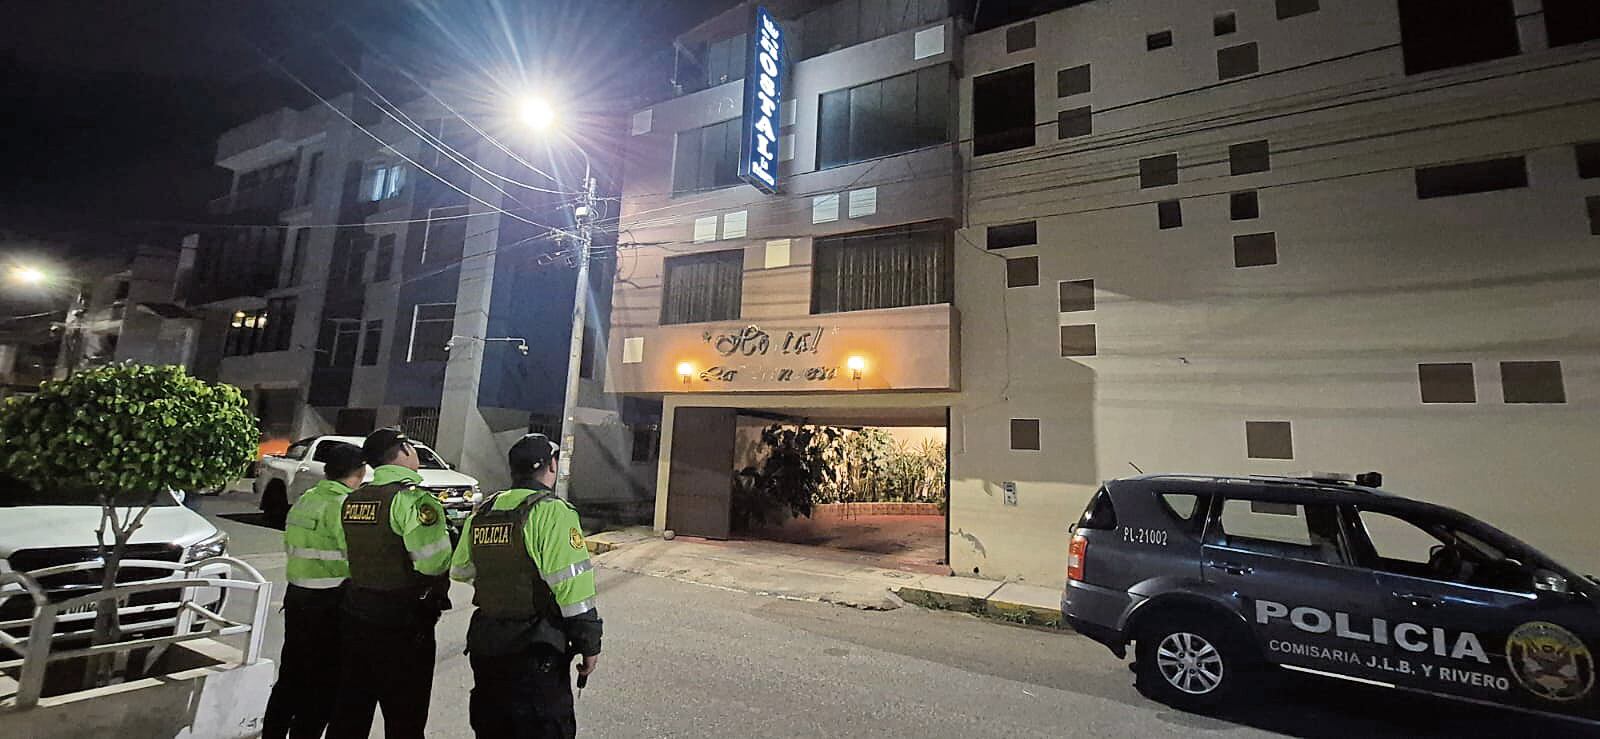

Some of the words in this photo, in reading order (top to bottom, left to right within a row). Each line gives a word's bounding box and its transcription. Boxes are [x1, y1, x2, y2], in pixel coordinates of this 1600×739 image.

[344, 502, 376, 520] POLICIA
[473, 526, 509, 545] POLICIA
[1123, 526, 1168, 546] PL-21002
[1255, 599, 1491, 664] POLICIA
[1269, 639, 1361, 665] COMISARIA
[1366, 655, 1416, 675] J.L.B.
[1421, 663, 1433, 677] Y
[1439, 667, 1510, 691] RIVERO
